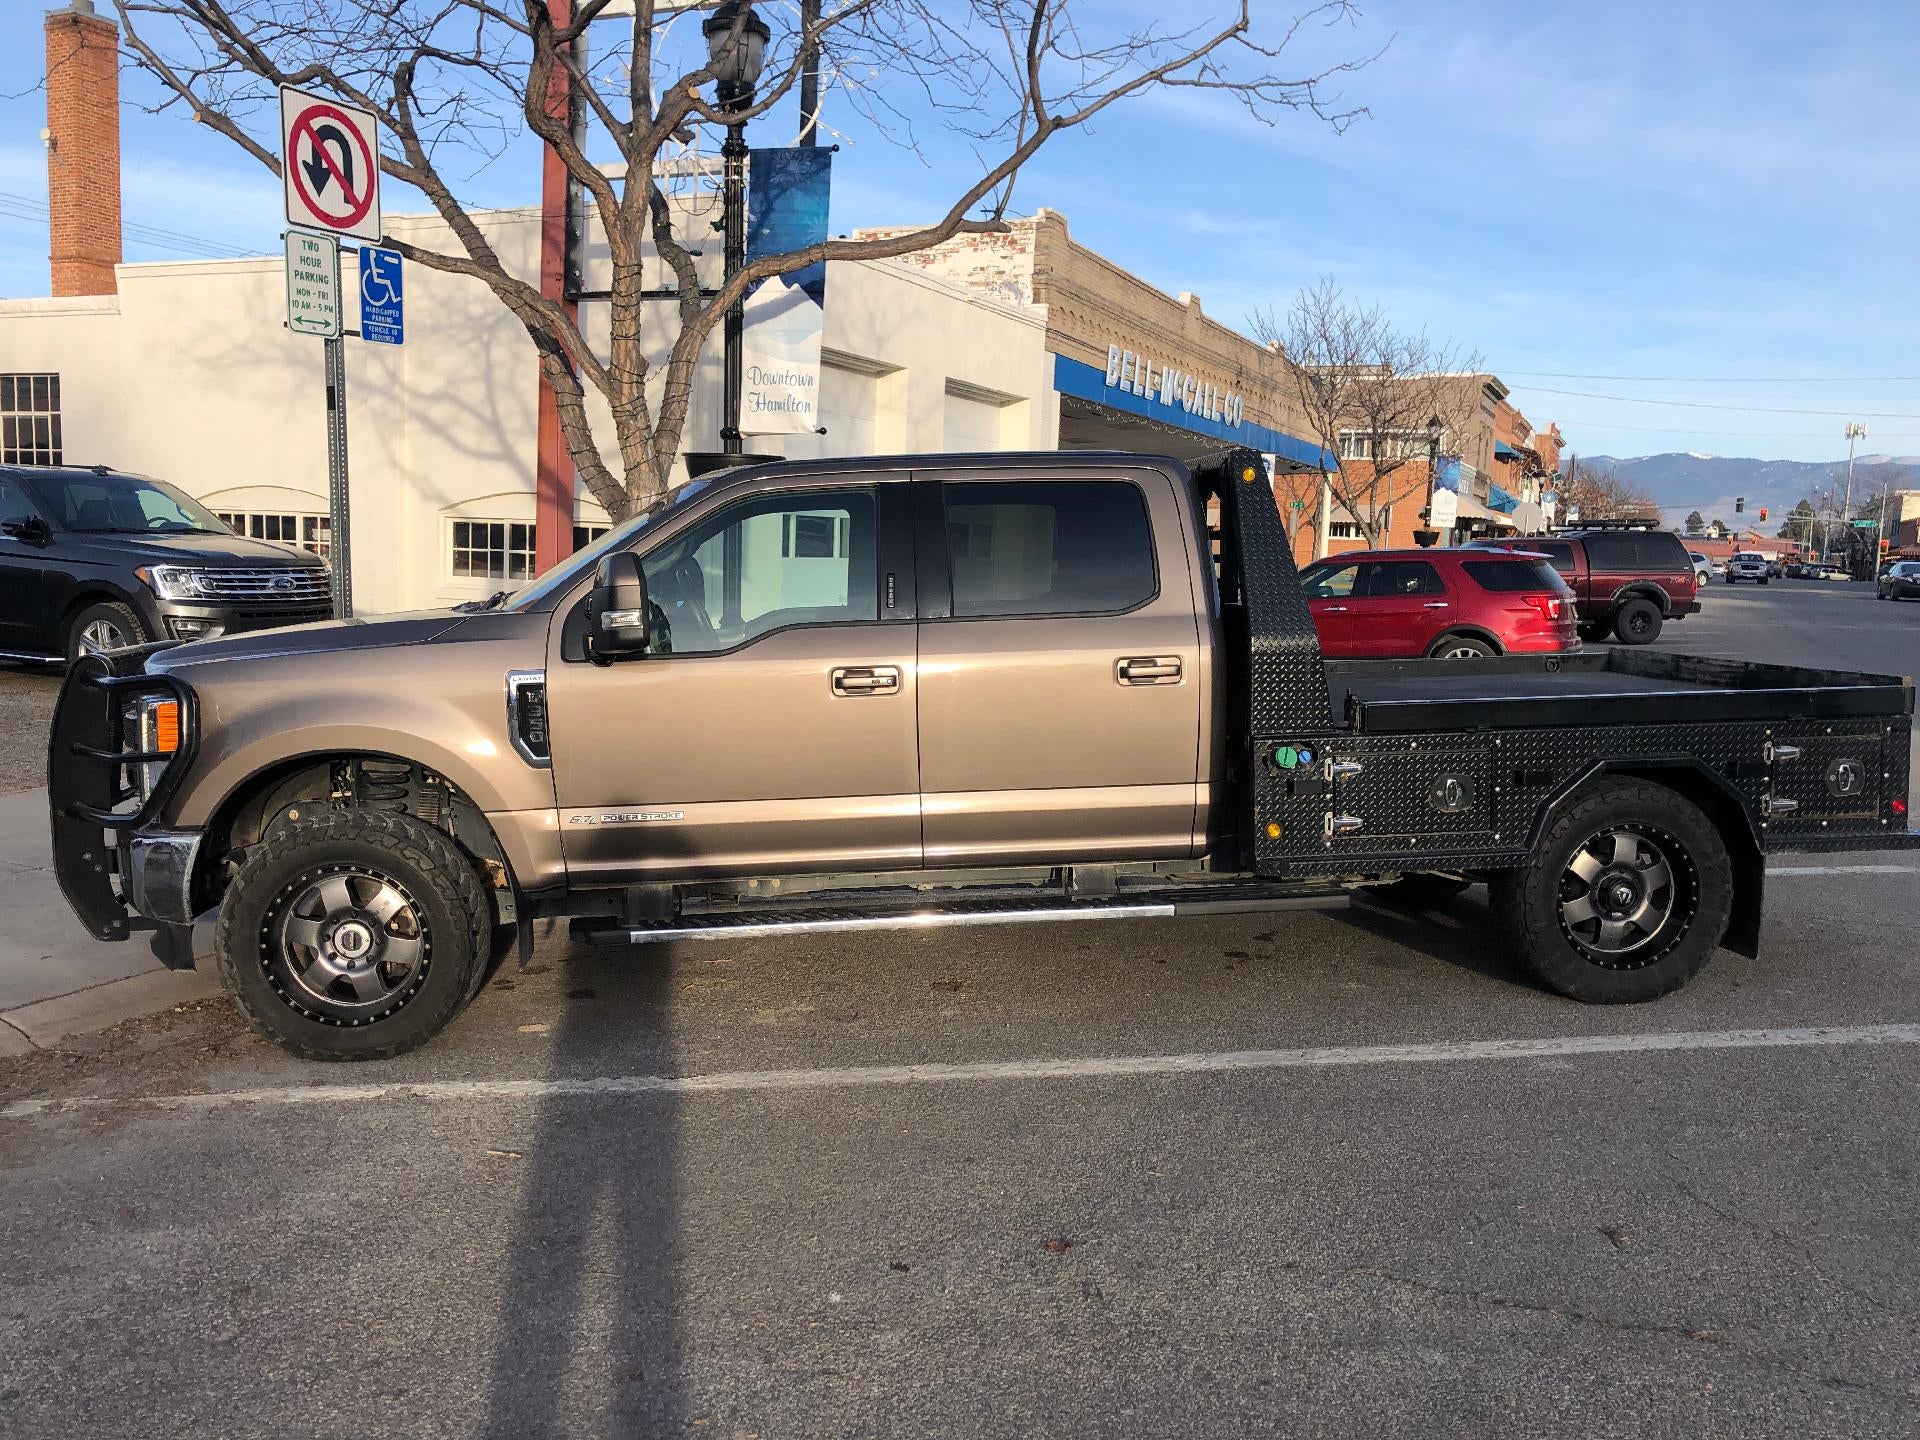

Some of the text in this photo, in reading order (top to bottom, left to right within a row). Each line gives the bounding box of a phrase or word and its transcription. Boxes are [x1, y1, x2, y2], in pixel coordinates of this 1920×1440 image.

[302, 240, 319, 252] TWO
[300, 256, 321, 268] HOUR
[294, 270, 329, 285] PARKING
[296, 288, 311, 297] MON
[318, 291, 328, 300] FRI
[292, 300, 299, 308] 10
[301, 301, 311, 310] AM
[324, 305, 333, 313] PM
[371, 315, 393, 323] PARKING
[747, 366, 813, 386] Downtown
[748, 392, 811, 413] Hamilton
[1223, 390, 1244, 429] CO
